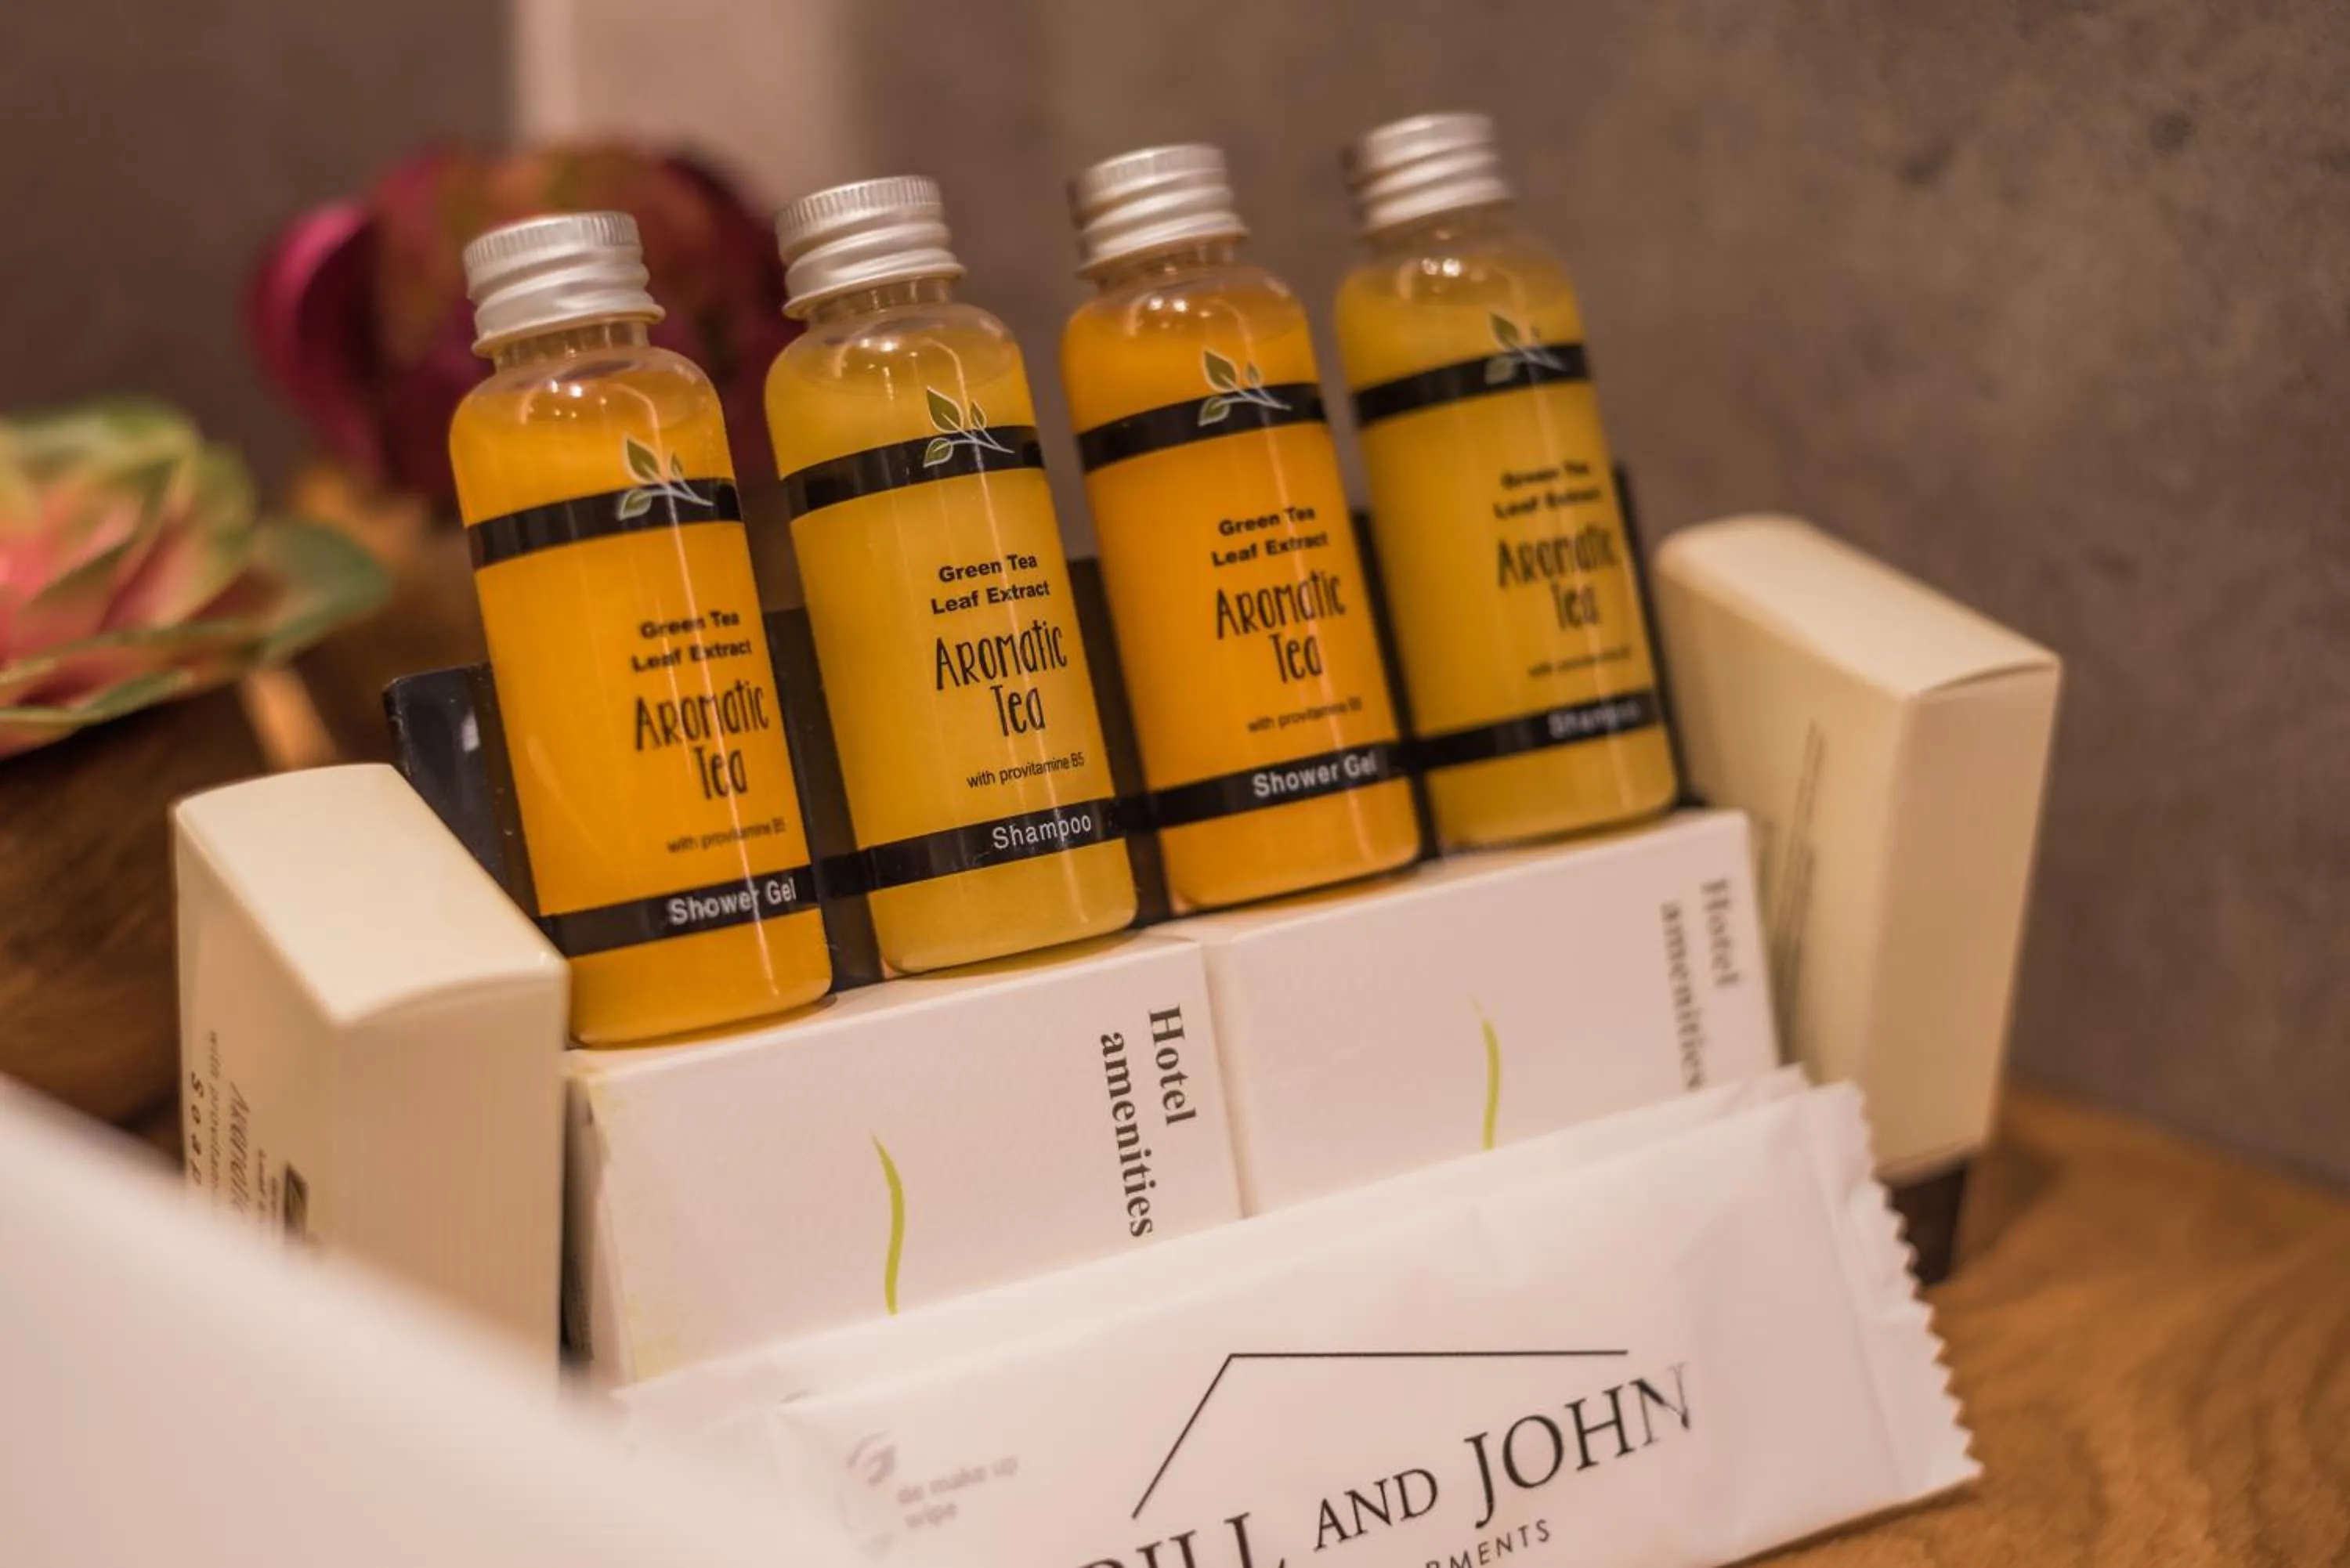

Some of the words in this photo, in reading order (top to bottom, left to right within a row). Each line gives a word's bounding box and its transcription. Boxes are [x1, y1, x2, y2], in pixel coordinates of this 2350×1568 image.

[1218, 513, 1280, 537] Green
[1284, 505, 1316, 522] Tea
[938, 561, 1003, 583] Green
[1007, 554, 1038, 571] Tea
[1211, 542, 1258, 567] Leaf
[1265, 530, 1329, 556] Extract
[931, 590, 978, 615] Leaf
[986, 580, 1050, 605] Extract
[640, 617, 706, 639] Green
[710, 610, 740, 627] Tea
[631, 646, 682, 672] Leaf
[689, 638, 753, 662] Extract
[936, 619, 1068, 691] Aromatic
[1268, 633, 1323, 684] Tea
[990, 684, 1046, 737] Tea
[695, 745, 748, 800] Tea
[966, 770, 996, 789] with
[999, 757, 1069, 785] provitamine
[1071, 751, 1085, 768] B5
[1253, 764, 1339, 797] Shower
[1343, 750, 1378, 779] Gel
[667, 835, 698, 854] with
[992, 815, 1091, 849] Shampoo
[668, 888, 760, 925] Shower
[765, 876, 797, 905] Gel
[1701, 877, 1741, 988] Hotel
[1661, 900, 1708, 1090] amenities
[1148, 1003, 1197, 1127] Hotel
[1101, 1031, 1156, 1238] amenities
[1313, 1468, 1438, 1553] AND
[1463, 1361, 1692, 1530] JOHN
